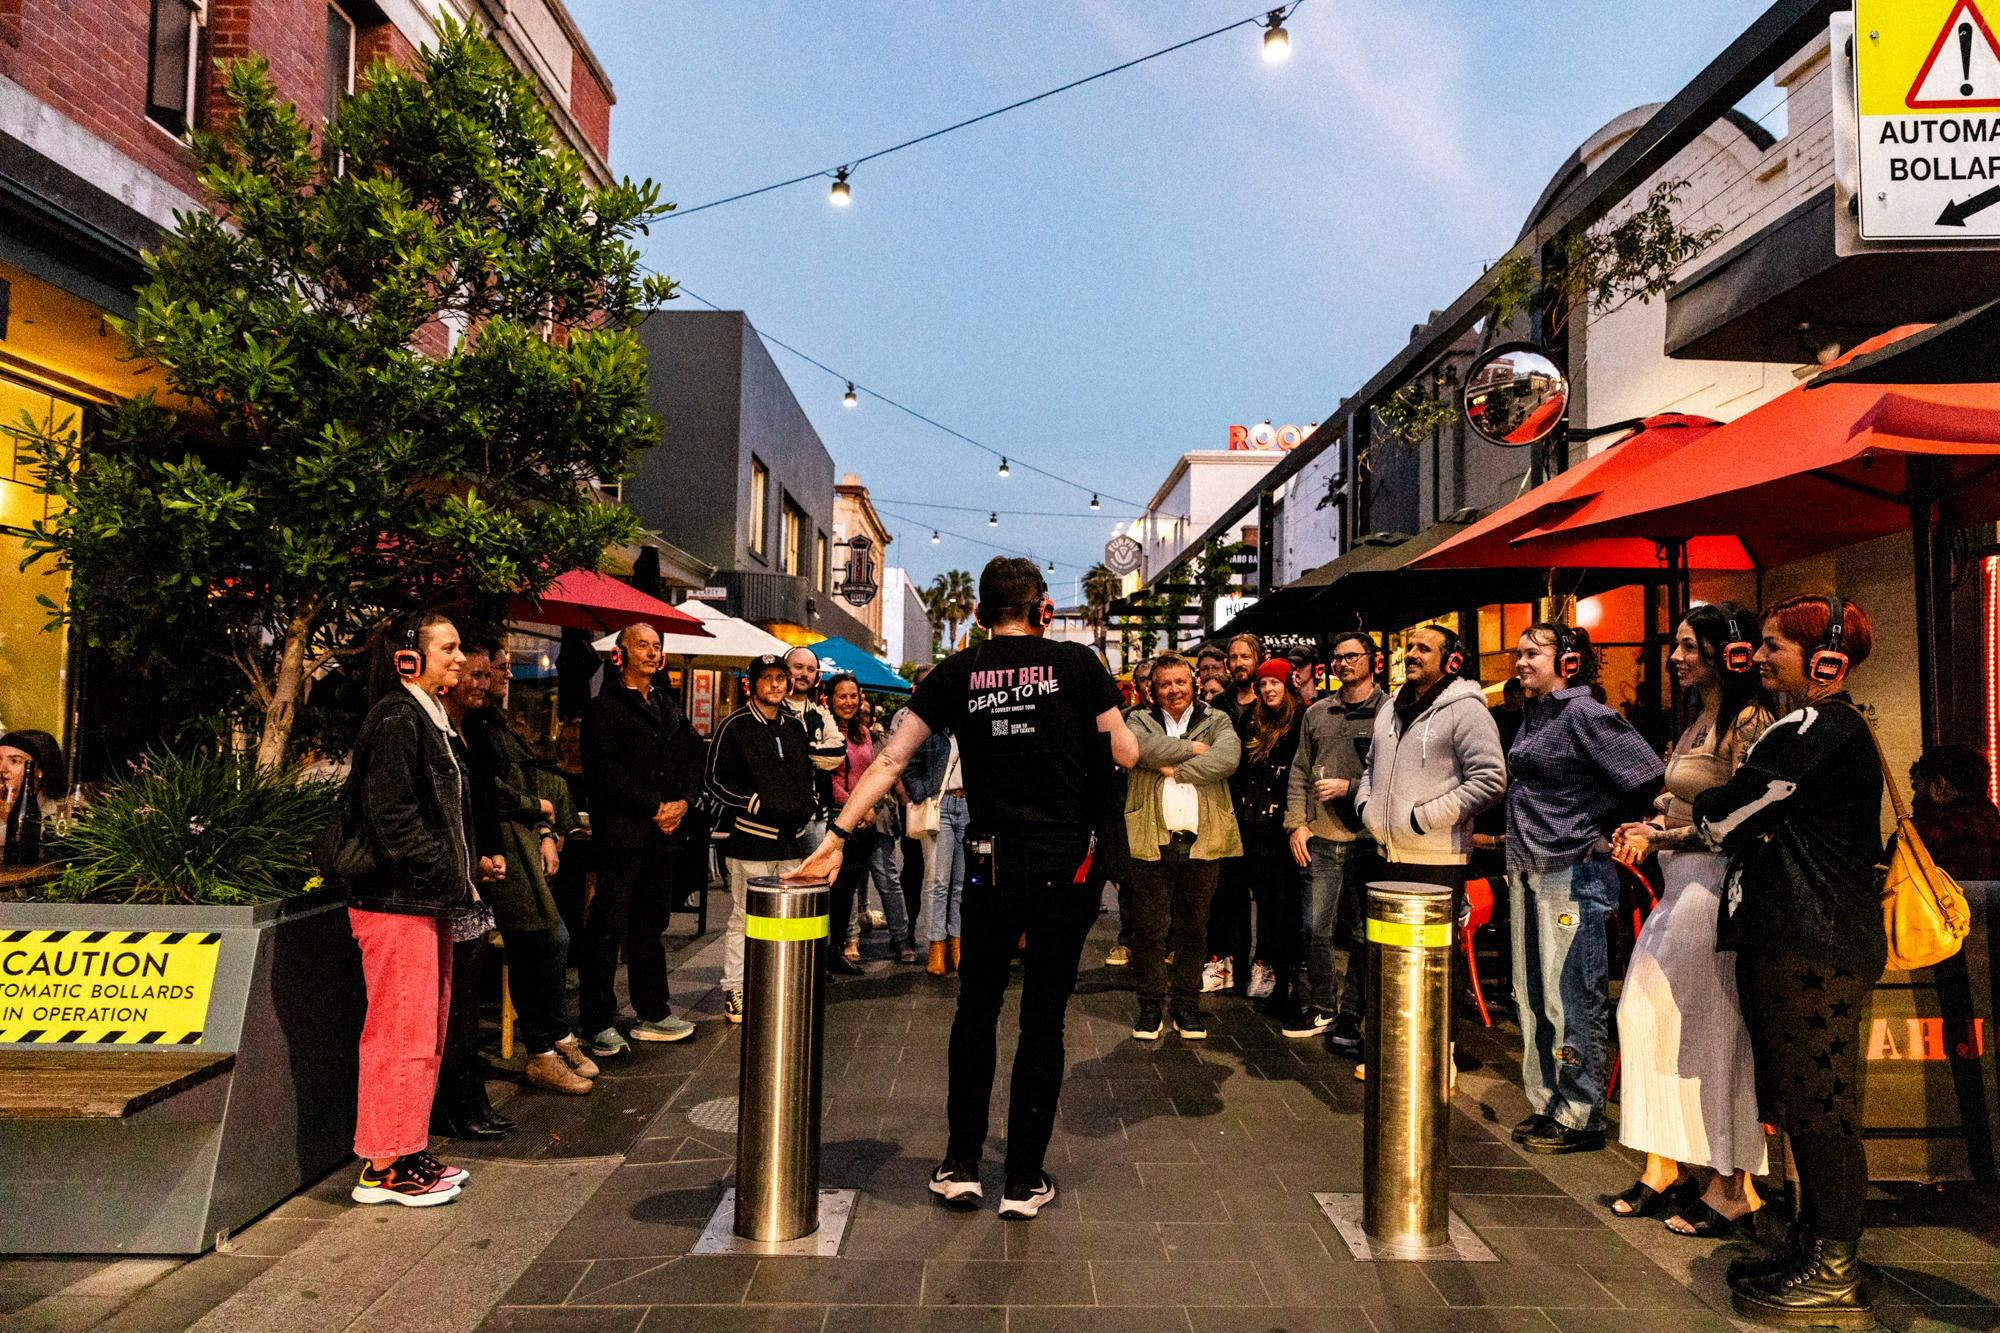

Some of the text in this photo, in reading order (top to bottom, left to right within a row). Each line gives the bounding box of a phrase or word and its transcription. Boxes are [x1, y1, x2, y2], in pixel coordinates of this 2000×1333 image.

[1879, 119, 2000, 144] AUTOMA
[1229, 554, 1247, 564] ANO
[1262, 636, 1316, 646] HICKEN
[970, 666, 1053, 690] MATT BELL
[968, 679, 1060, 713] DEAD TO ME
[2, 951, 169, 977] CAUTION
[91, 983, 195, 999] BOLLARDS
[3, 1006, 148, 1022] IN OPERATION
